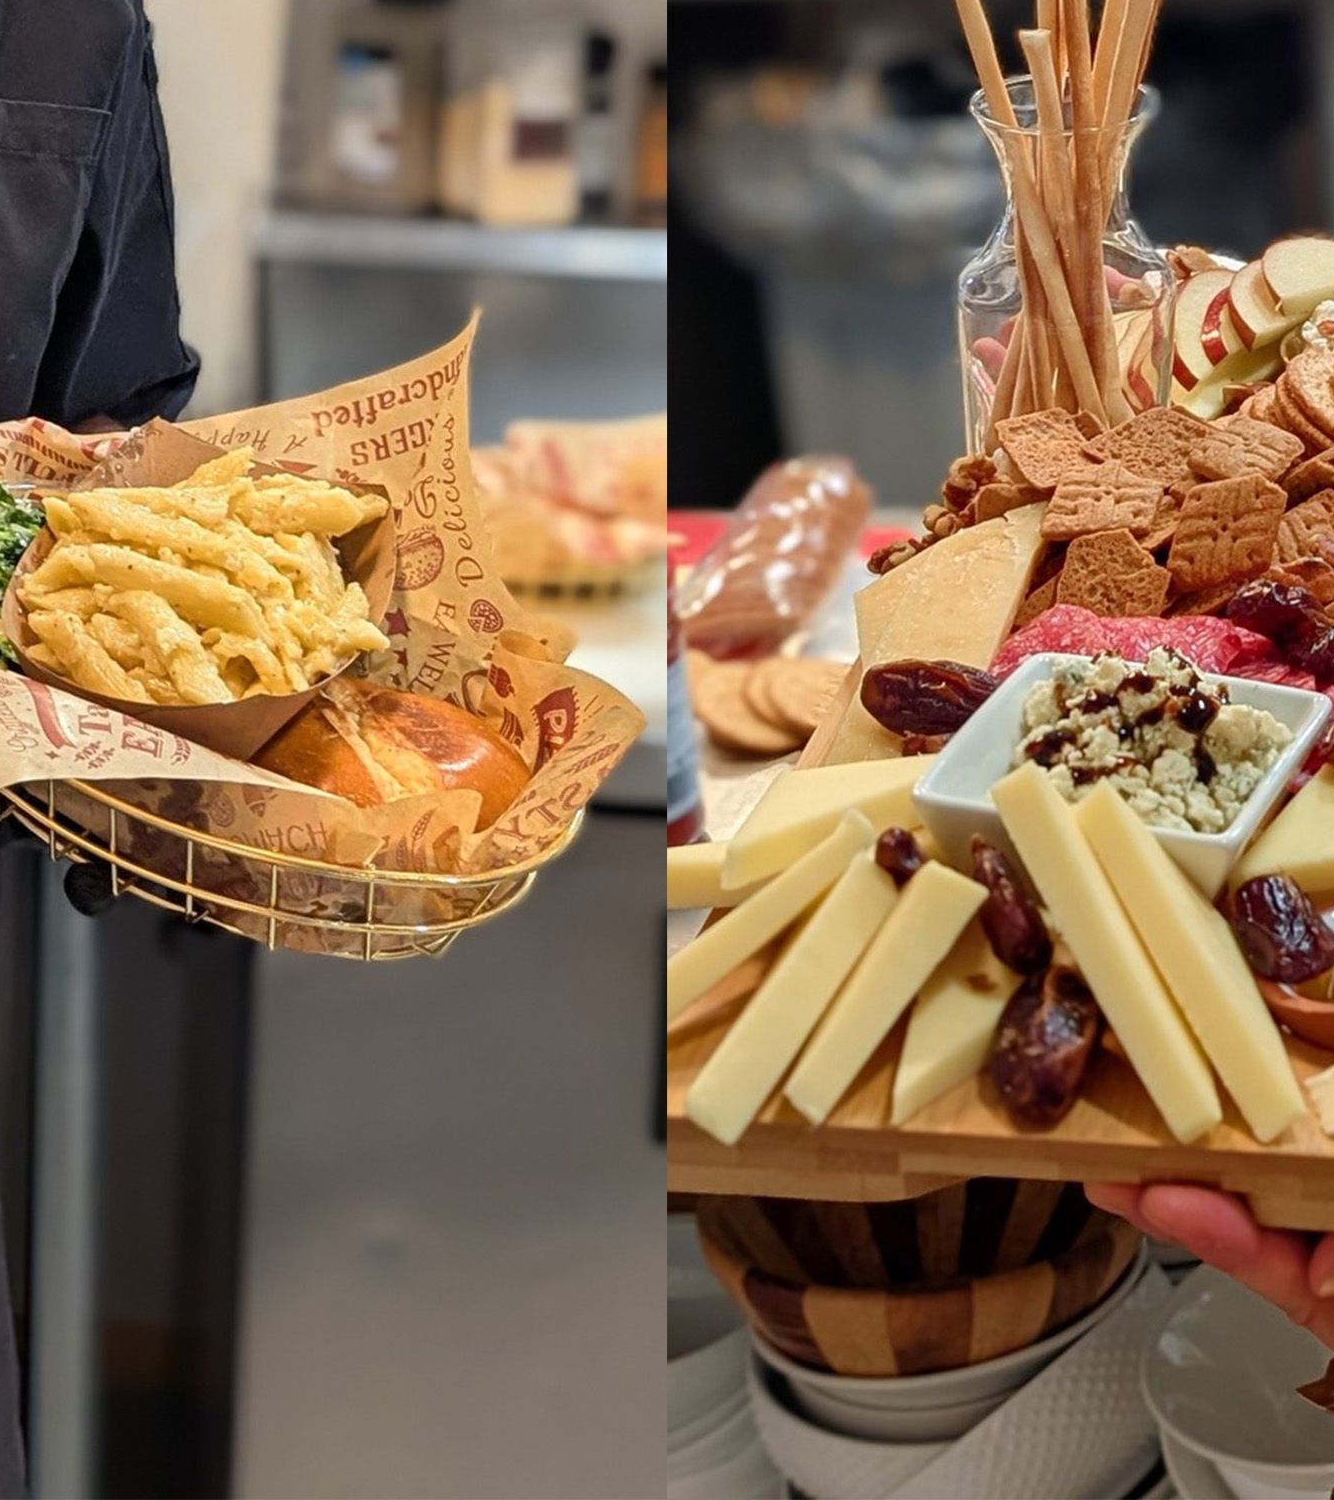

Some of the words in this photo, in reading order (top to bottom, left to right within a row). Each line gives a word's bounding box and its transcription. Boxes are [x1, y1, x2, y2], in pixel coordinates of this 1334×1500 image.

[197, 427, 271, 452] Happ
[443, 413, 484, 588] Delicious
[407, 641, 456, 694] WEL
